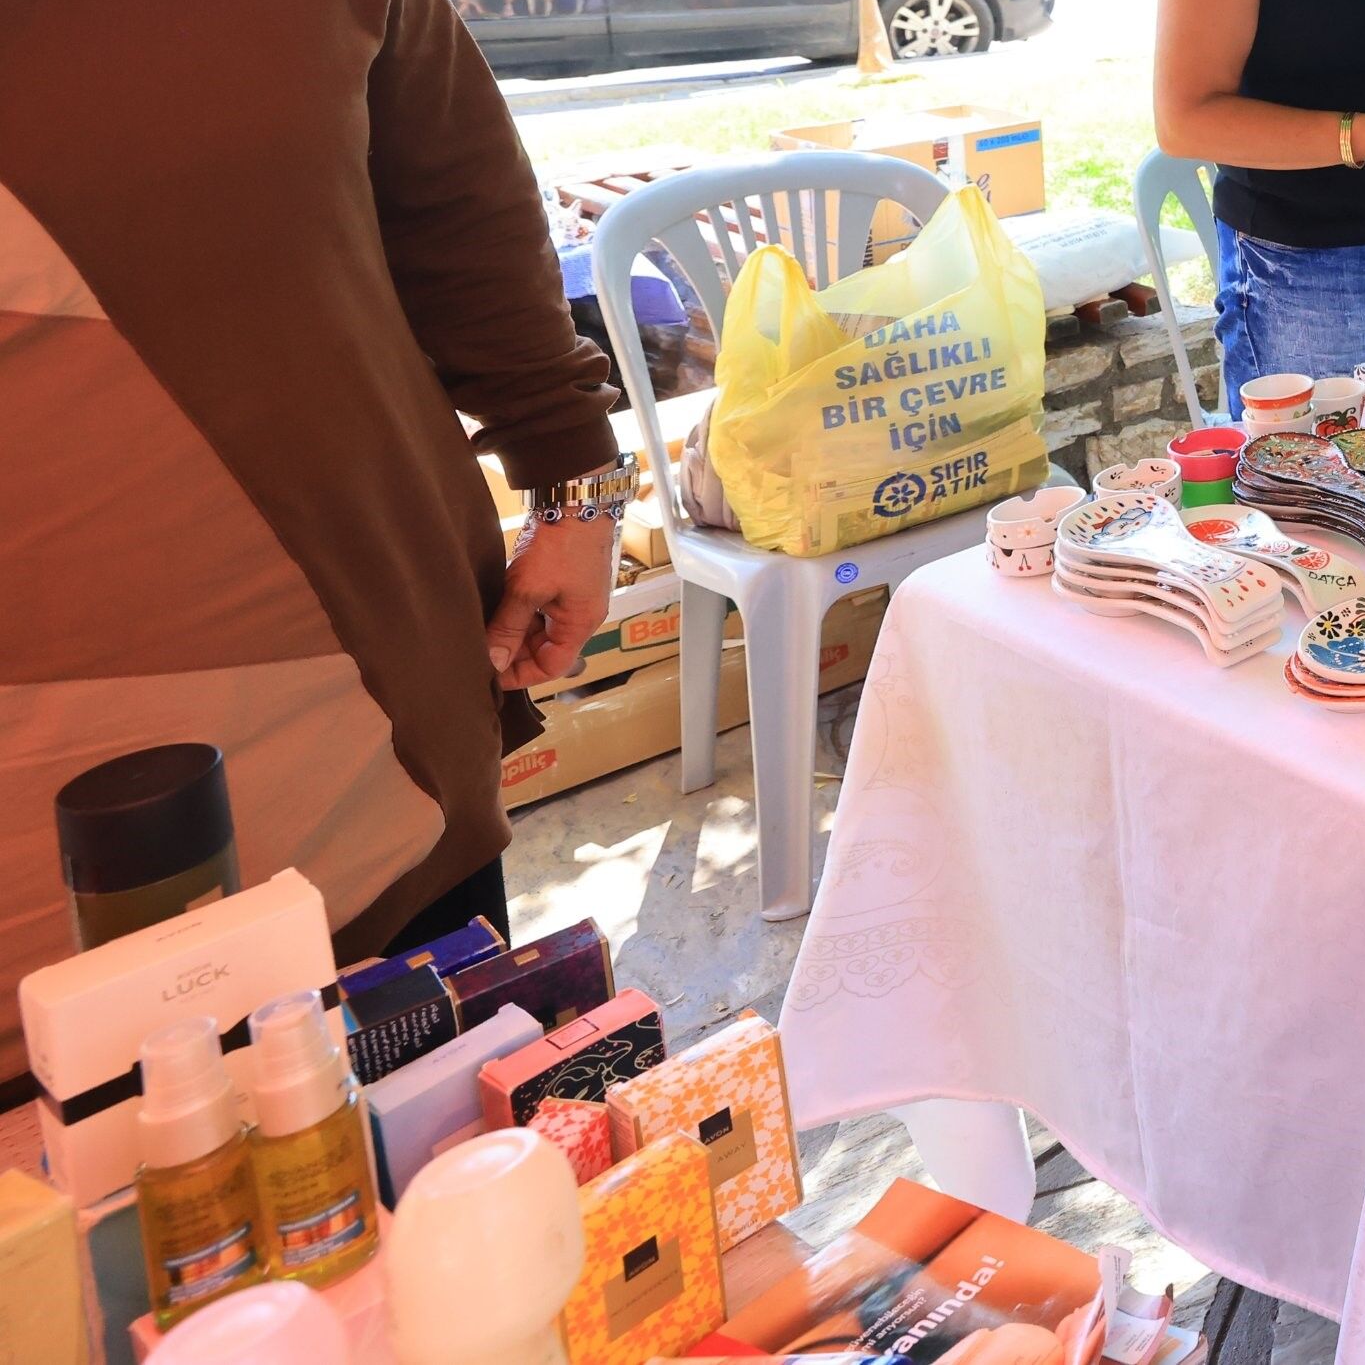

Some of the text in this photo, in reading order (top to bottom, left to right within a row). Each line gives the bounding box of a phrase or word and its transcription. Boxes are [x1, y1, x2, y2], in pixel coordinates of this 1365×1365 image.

[864, 310, 960, 350] DAHA
[835, 337, 991, 391] SAĞLIKLI
[821, 367, 1007, 431] BİR ÇEVRE
[888, 412, 962, 454] İÇİN
[930, 451, 989, 485] SIFIR
[929, 473, 988, 502] ATIK
[1308, 571, 1357, 590] DATÇA
[161, 964, 230, 1001] LUCK
[704, 1126, 730, 1145] AVON
